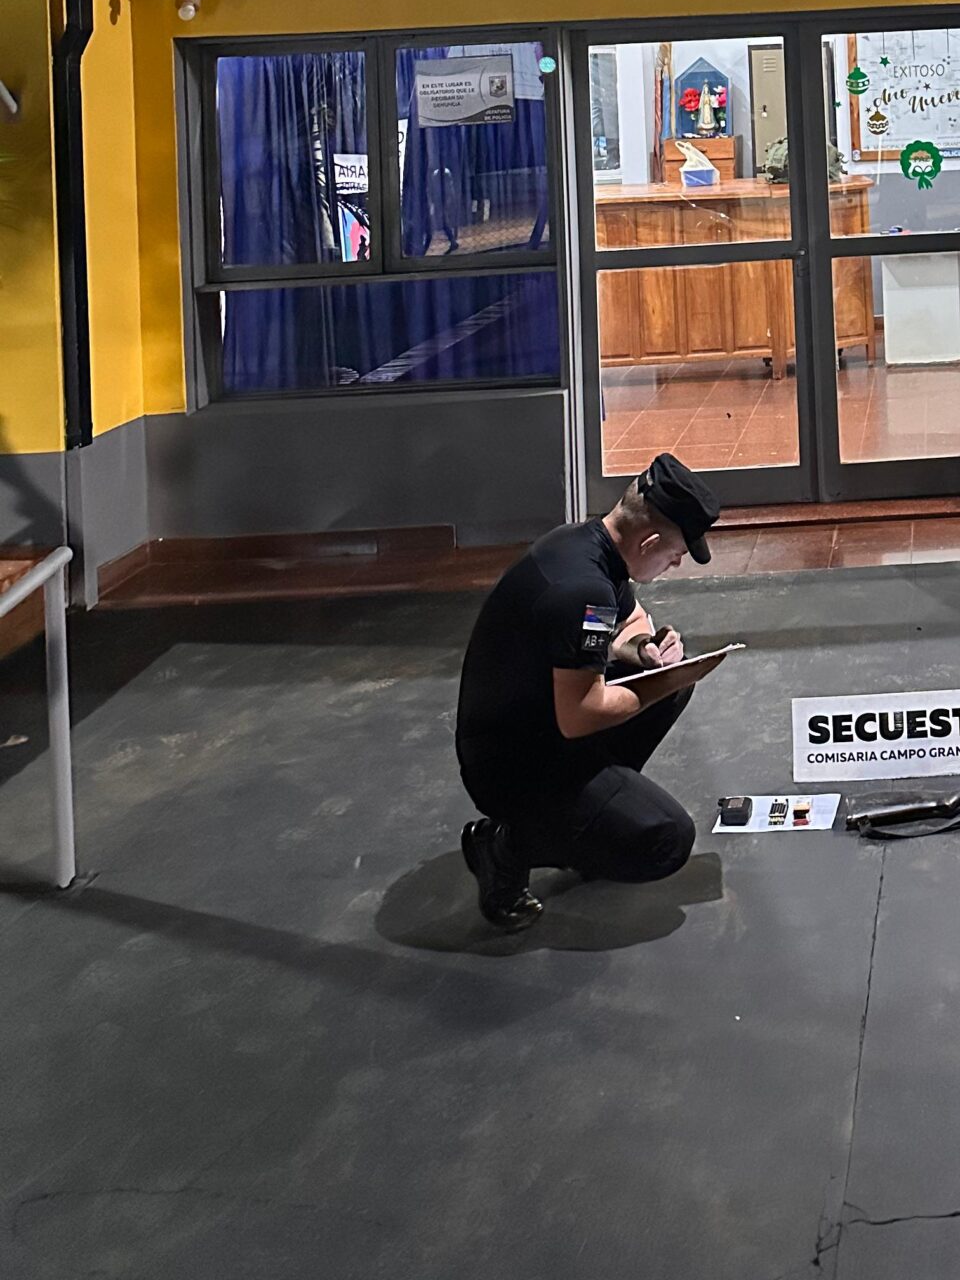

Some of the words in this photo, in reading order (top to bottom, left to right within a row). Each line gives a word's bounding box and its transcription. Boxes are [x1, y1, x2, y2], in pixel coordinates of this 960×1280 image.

[893, 64, 945, 78] EXITOSO
[584, 635, 605, 647] AB+
[807, 750, 877, 764] COMISARIA
[880, 748, 926, 761] CAMPO
